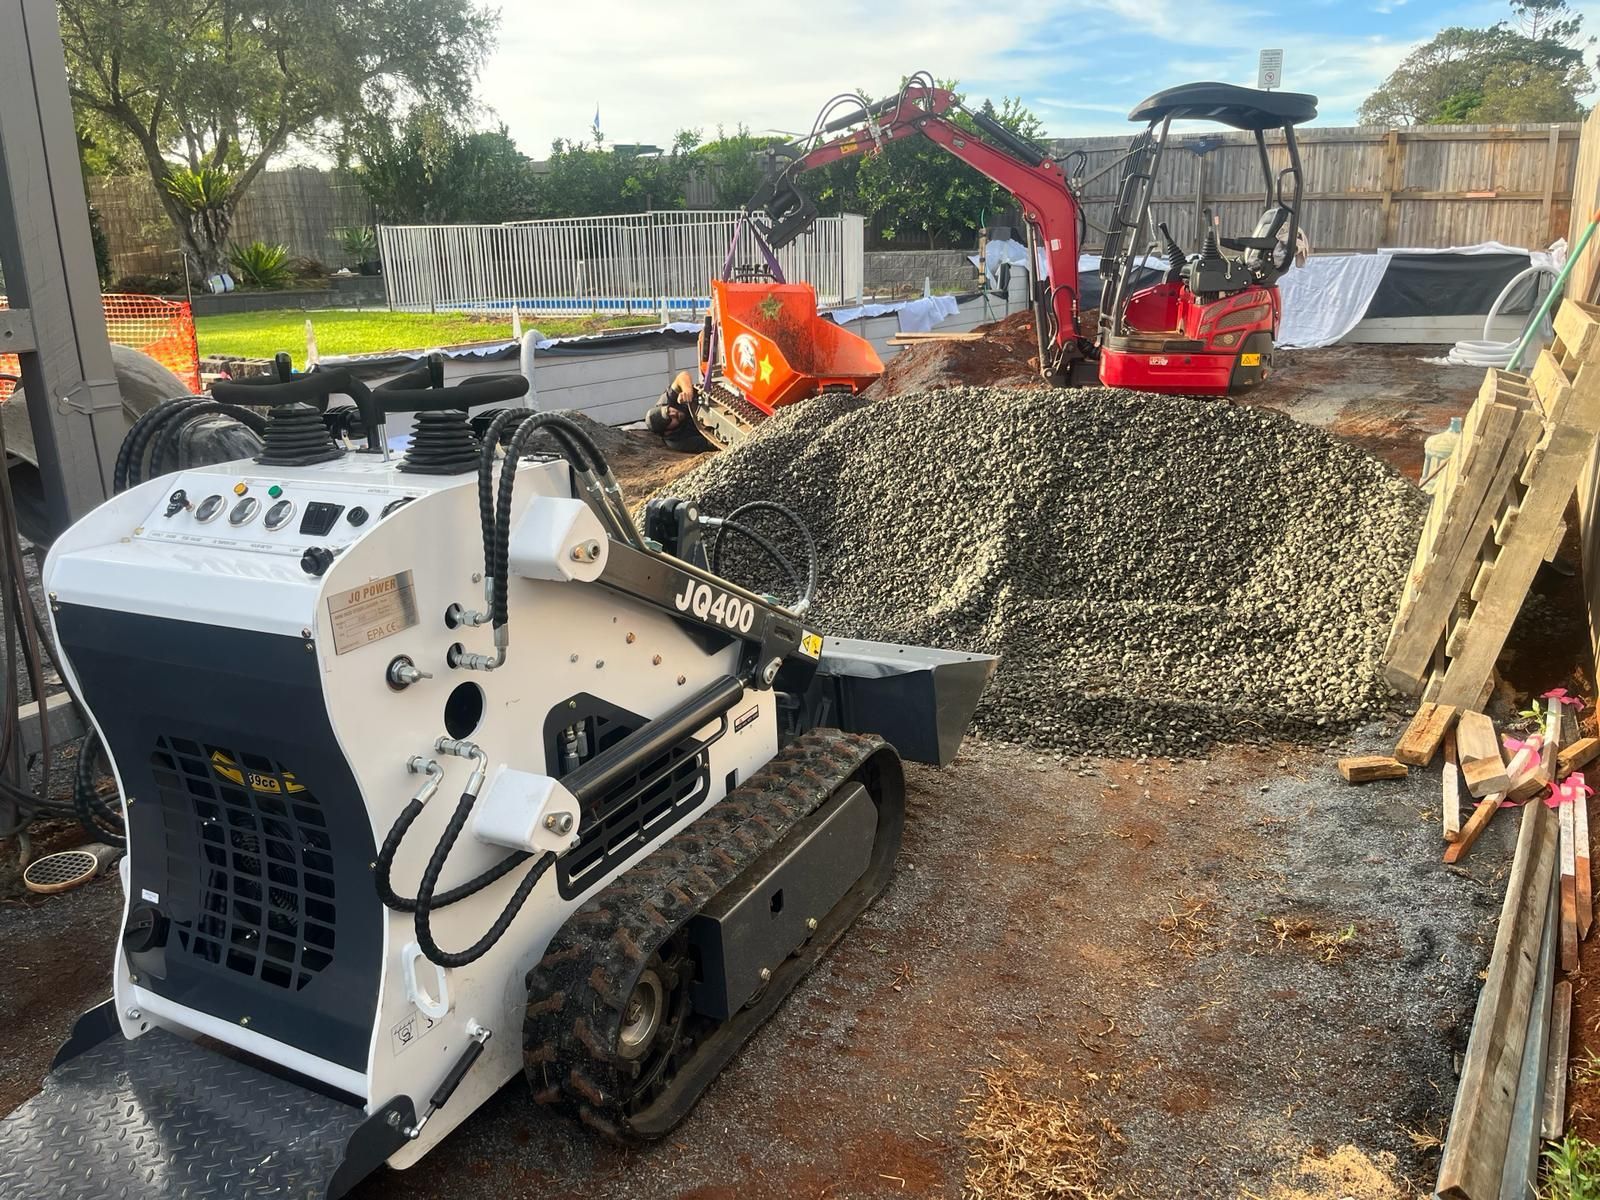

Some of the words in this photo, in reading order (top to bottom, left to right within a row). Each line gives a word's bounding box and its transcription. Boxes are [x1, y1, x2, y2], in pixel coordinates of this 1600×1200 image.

[348, 590, 360, 604] JQ
[363, 579, 396, 598] POWER
[675, 579, 755, 633] JQ400
[367, 627, 385, 641] EPA
